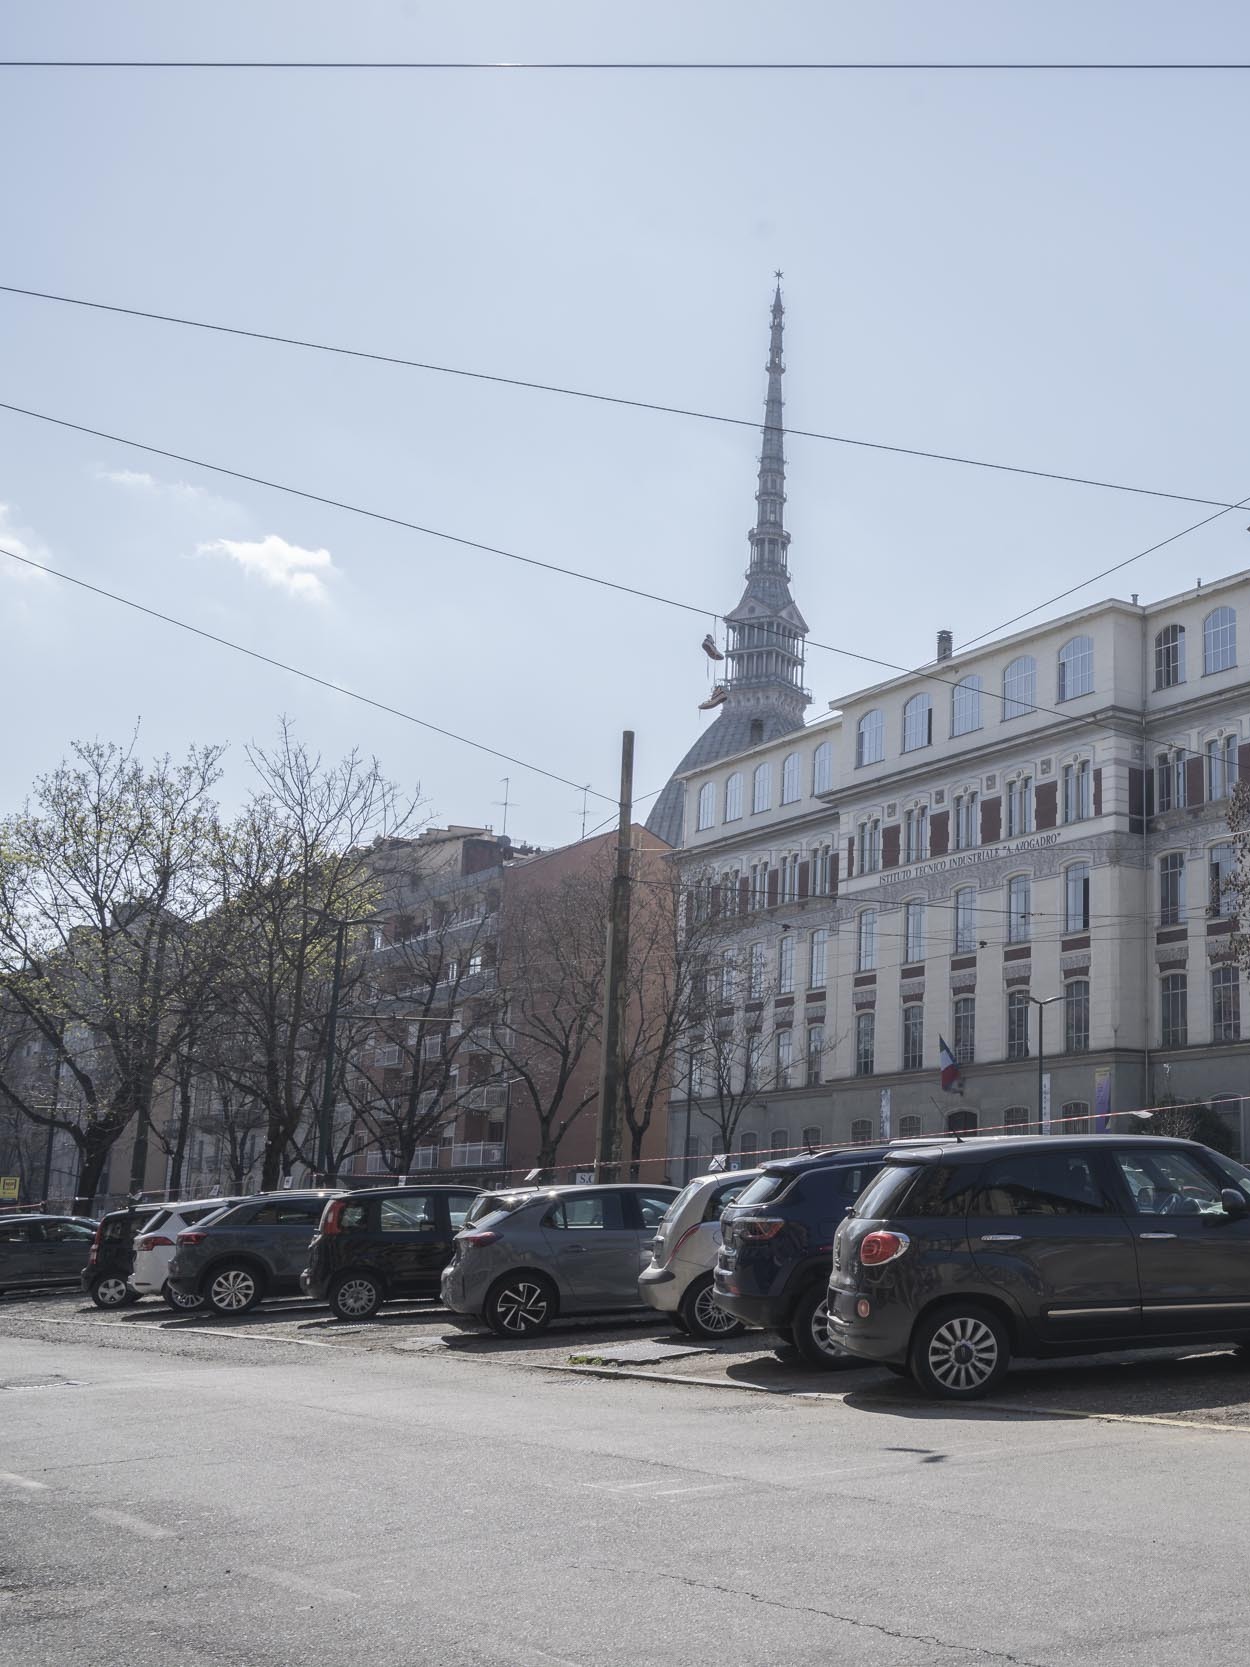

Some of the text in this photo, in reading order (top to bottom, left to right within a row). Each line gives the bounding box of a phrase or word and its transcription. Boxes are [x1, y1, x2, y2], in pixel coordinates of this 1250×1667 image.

[879, 869, 911, 885] ISTITUTO
[914, 860, 946, 879] TECNICO
[949, 848, 999, 868] INDUSTRIALE
